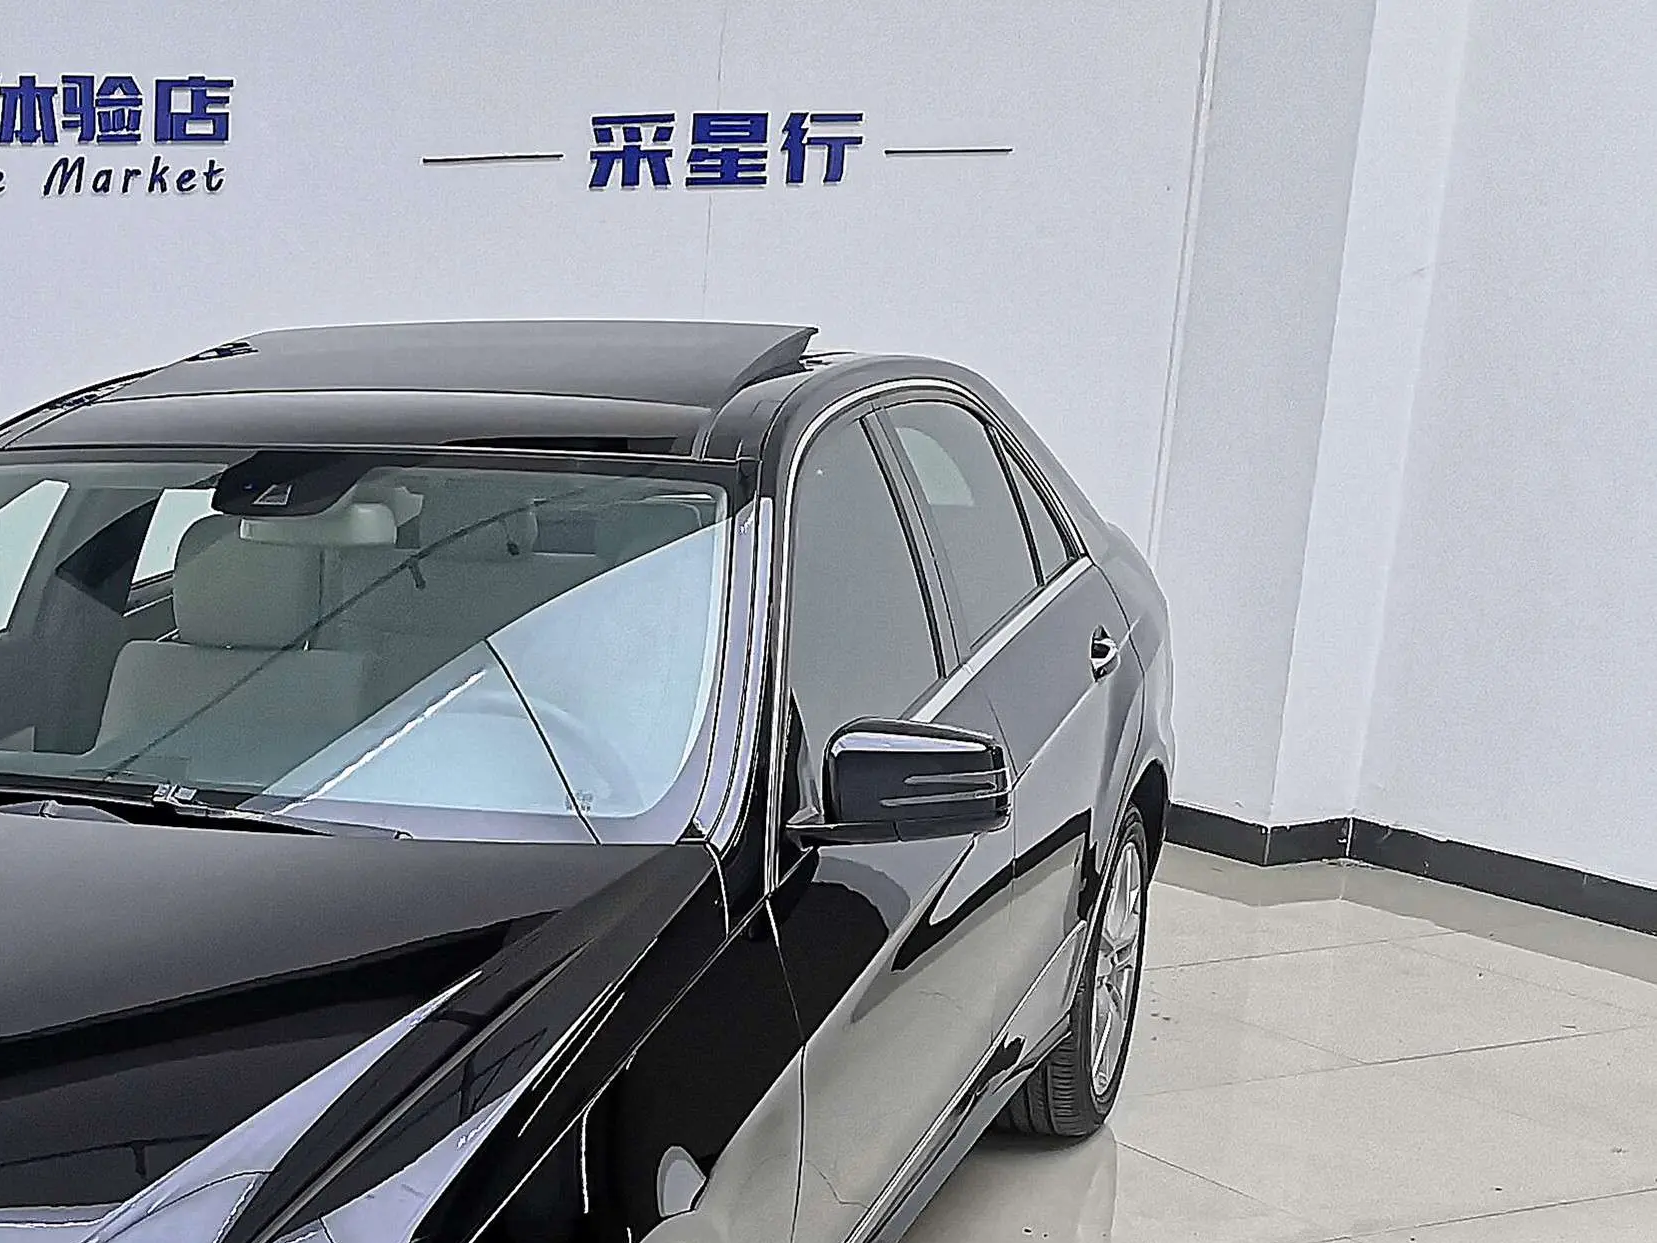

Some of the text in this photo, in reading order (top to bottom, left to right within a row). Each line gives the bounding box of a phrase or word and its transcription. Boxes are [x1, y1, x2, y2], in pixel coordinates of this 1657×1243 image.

[43, 155, 225, 197] Market
[588, 111, 865, 189] 采星行
